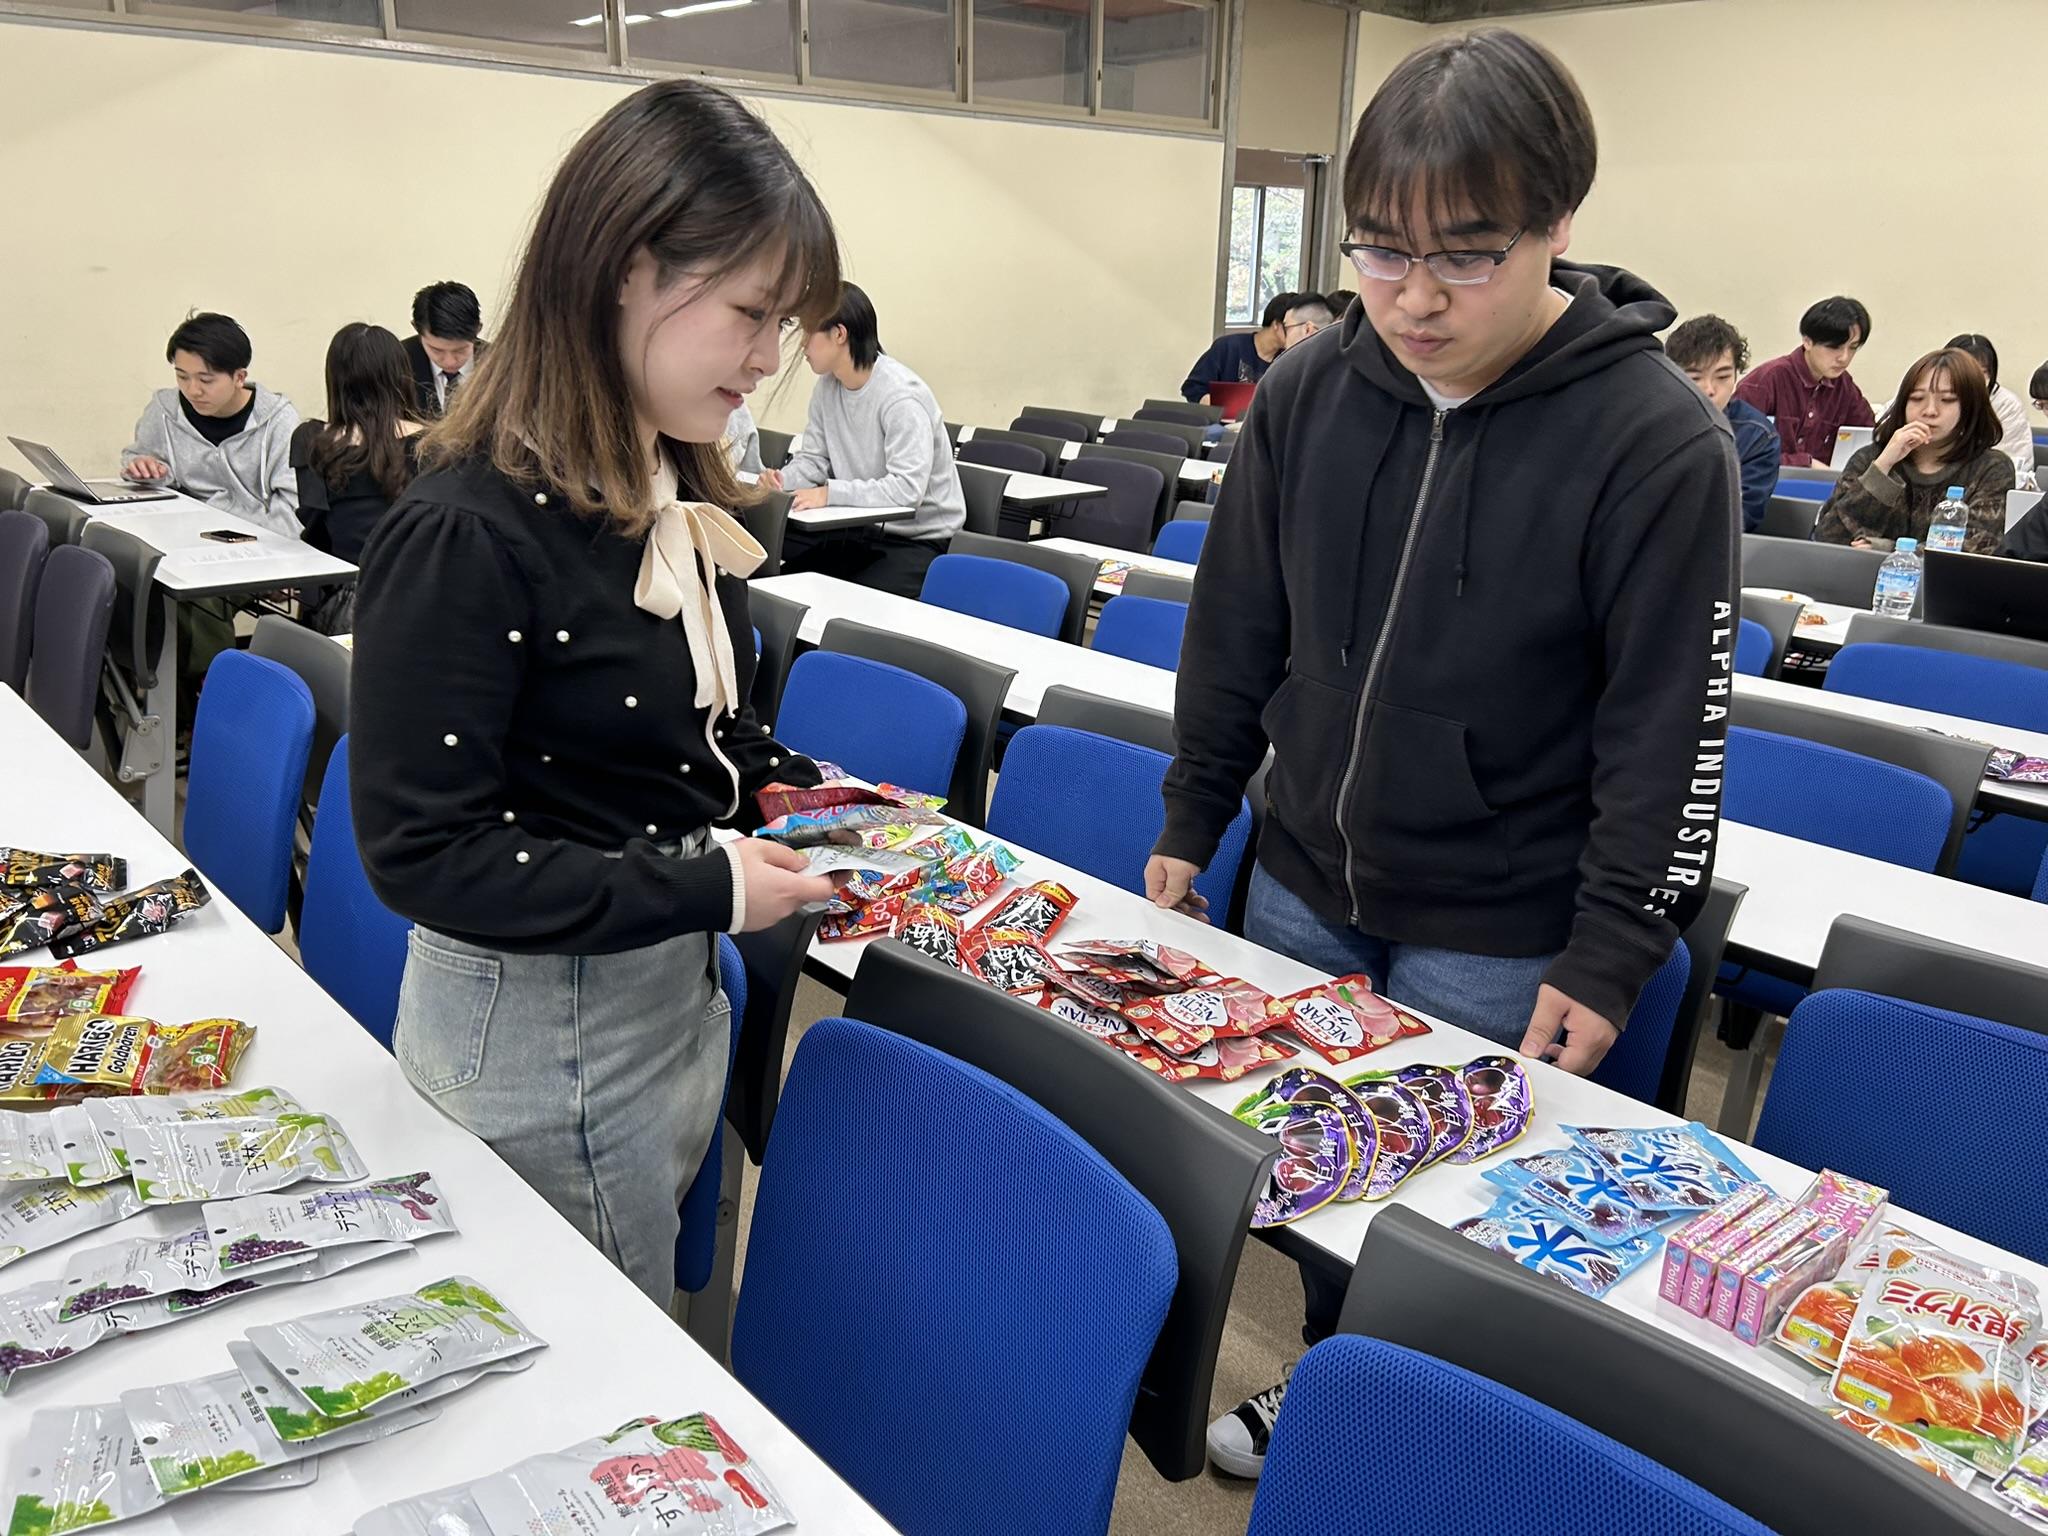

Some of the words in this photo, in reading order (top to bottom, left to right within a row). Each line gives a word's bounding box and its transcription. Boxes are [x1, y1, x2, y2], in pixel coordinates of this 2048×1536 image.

[1703, 601, 1731, 722] ALPHA
[1643, 739, 1725, 918] INDUSTRE
[1057, 1005, 1121, 1031] NECTAR
[1300, 1002, 1352, 1043] NECTAR
[66, 1018, 117, 1074] HARIBO
[108, 1025, 141, 1074] Goldbären
[1664, 1261, 1680, 1300] Poifull
[1688, 1274, 1704, 1312] Poifull
[1715, 1287, 1732, 1325] Poifull
[1741, 1284, 1760, 1325] Poifull
[1881, 1279, 2025, 1345] 果汁グミ
